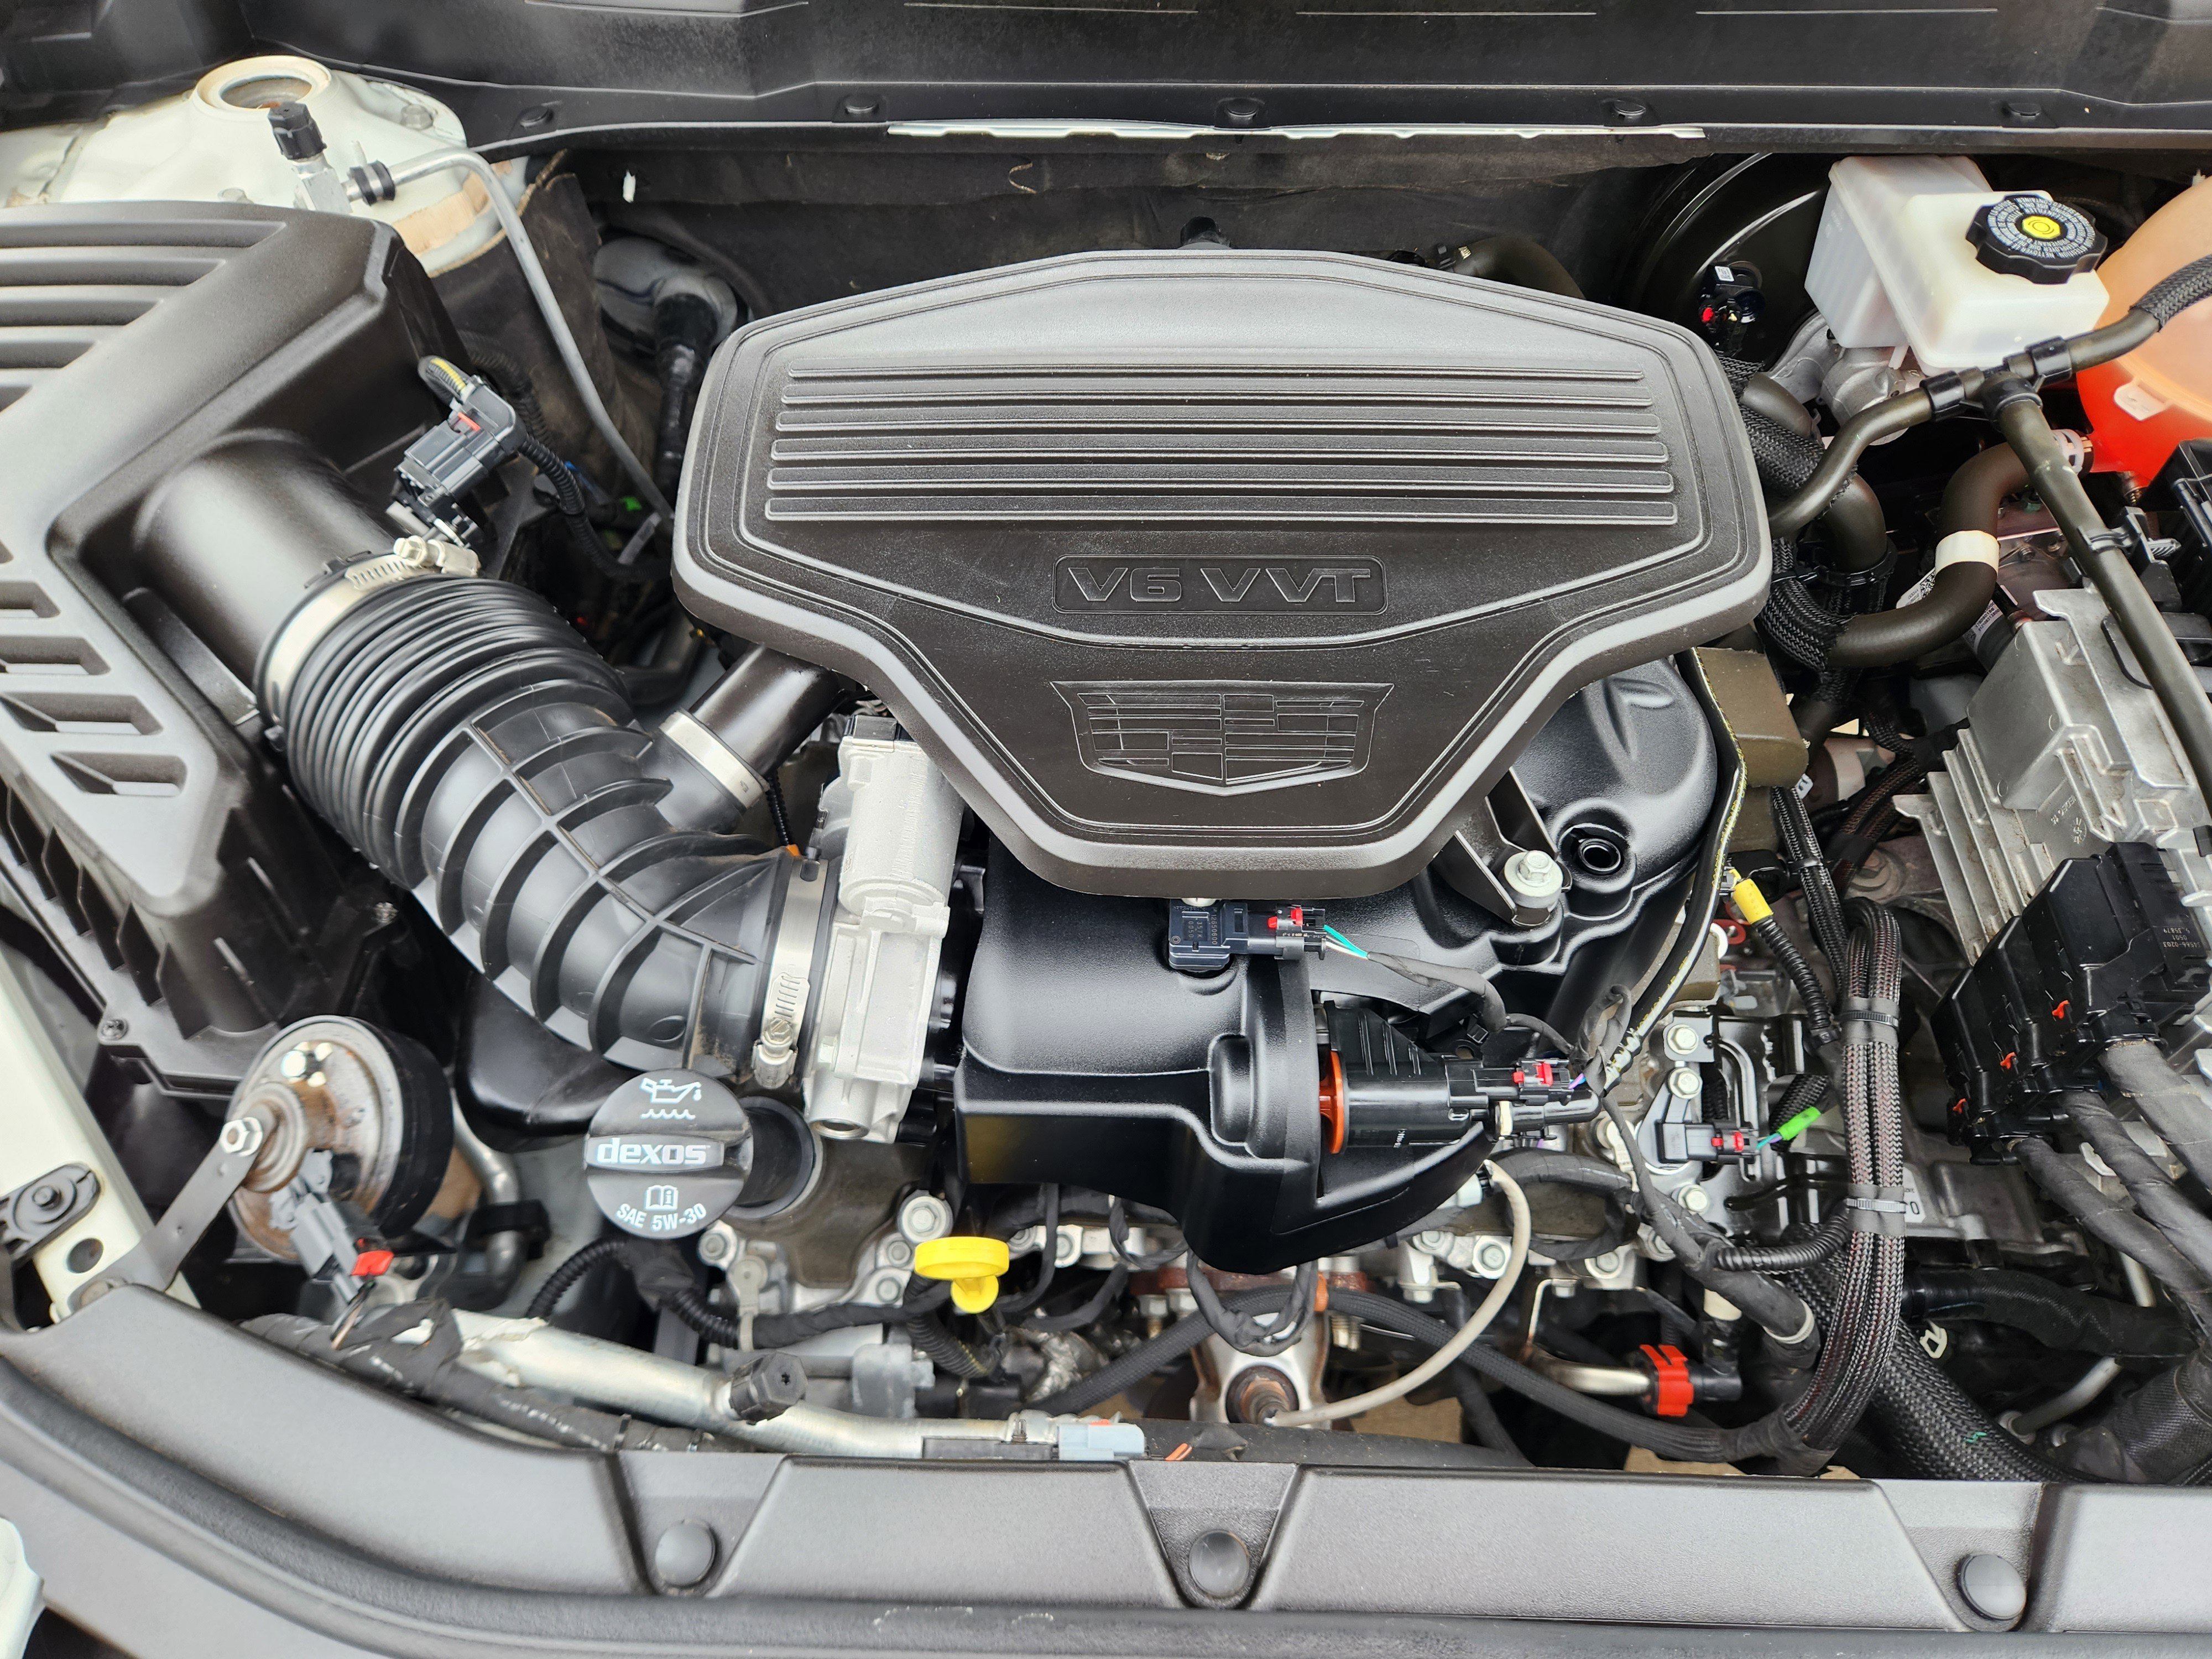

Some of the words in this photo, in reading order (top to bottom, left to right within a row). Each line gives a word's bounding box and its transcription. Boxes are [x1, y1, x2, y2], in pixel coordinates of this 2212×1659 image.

[1068, 567, 1182, 602] V6
[1200, 568, 1371, 602] VVT
[596, 1137, 707, 1165] dexos
[616, 1203, 647, 1228] SAE
[652, 1203, 707, 1230] 5W-30
